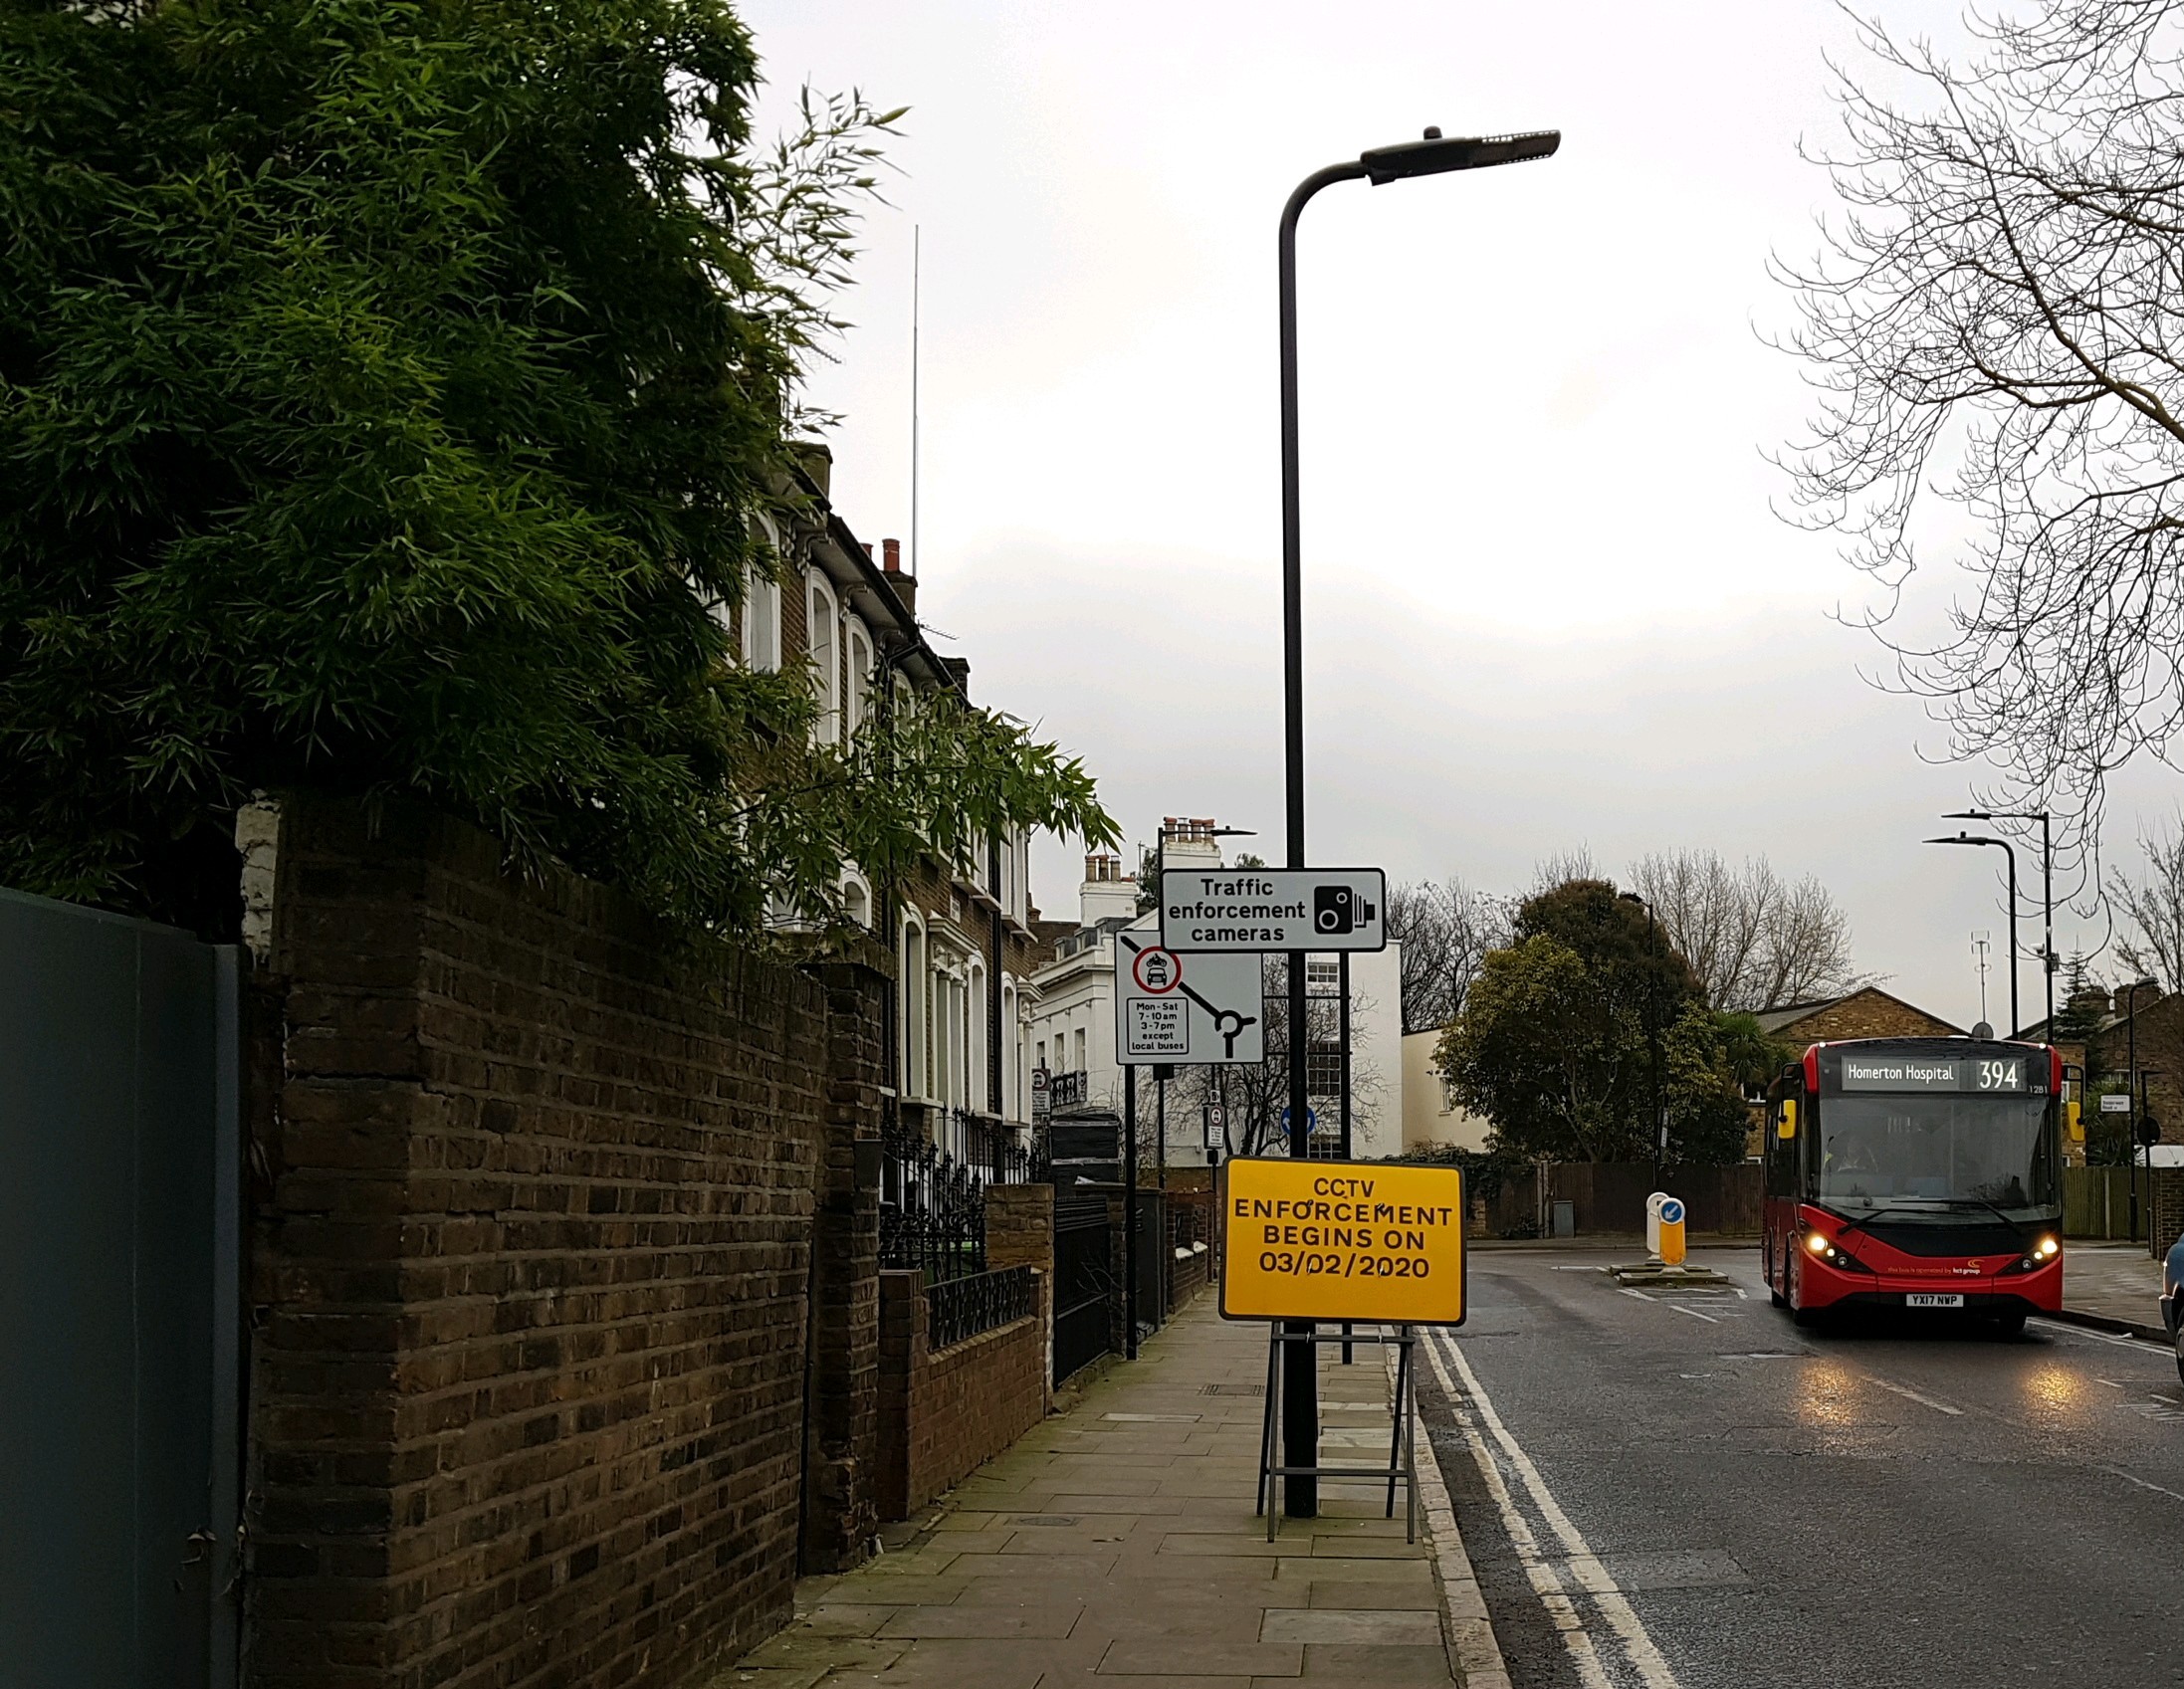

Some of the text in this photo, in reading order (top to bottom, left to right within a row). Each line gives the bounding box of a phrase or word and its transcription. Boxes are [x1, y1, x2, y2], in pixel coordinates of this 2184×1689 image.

[1201, 878, 1273, 896] Traffic
[1169, 901, 1306, 919] enforcement
[1192, 927, 1284, 942] cameras
[1849, 1064, 1954, 1084] Homerton Hospital
[1979, 1061, 2018, 1089] 394
[2030, 1085, 2048, 1094] 1281
[1314, 1177, 1375, 1198] CCTV
[1234, 1198, 1452, 1226] ENFORCEMENT
[1263, 1225, 1424, 1250] BEGINS ON
[1259, 1250, 1429, 1278] 03/02/2020
[1913, 1296, 1957, 1305] YX17 NWP
